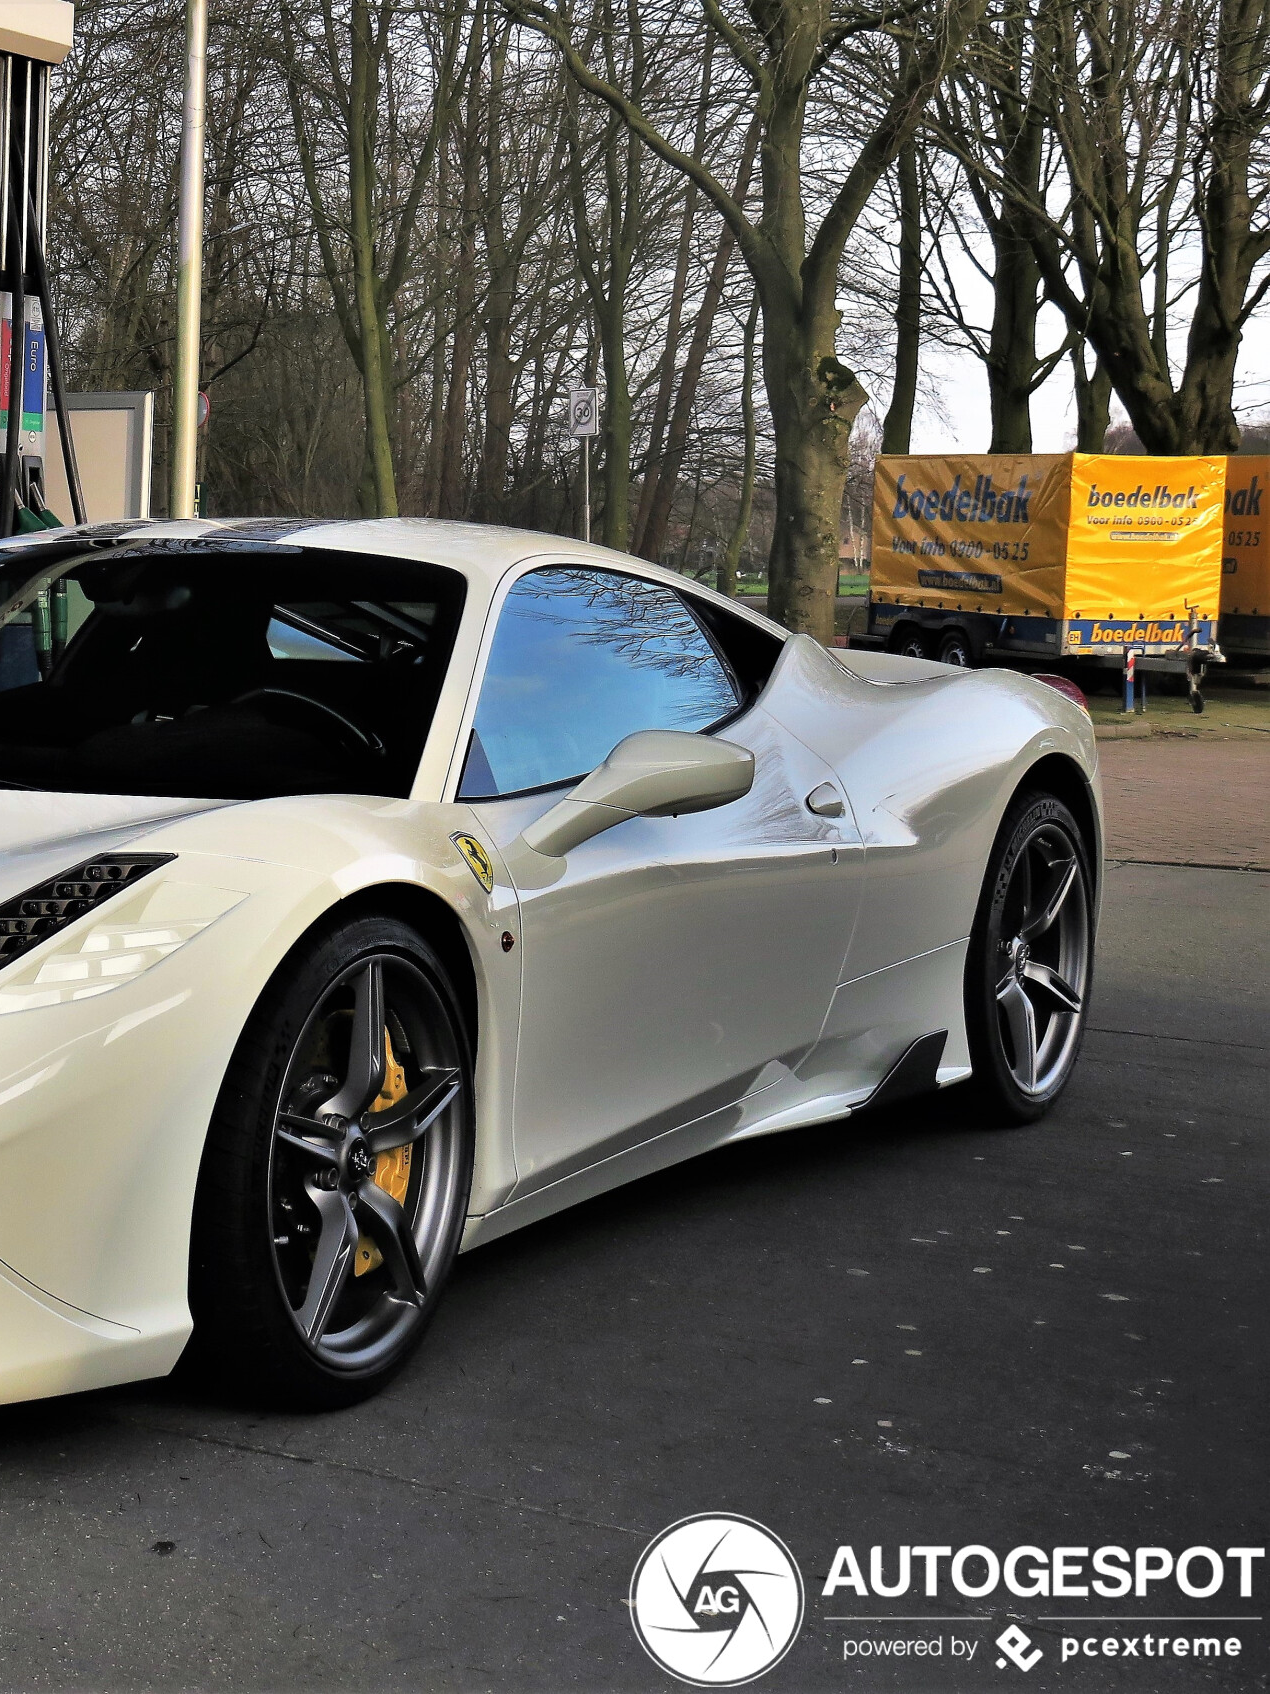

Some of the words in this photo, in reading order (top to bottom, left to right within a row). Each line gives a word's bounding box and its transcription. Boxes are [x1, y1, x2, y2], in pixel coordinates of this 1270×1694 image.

[30, 341, 39, 372] Euro
[577, 408, 590, 418] 30
[893, 474, 1033, 523] boedelbak
[1087, 484, 1200, 509] boedelbak
[1086, 515, 1110, 525] Voor
[1112, 515, 1133, 525] info
[893, 536, 918, 555] Voor
[920, 536, 946, 556] info
[1091, 622, 1185, 643] boedelbak
